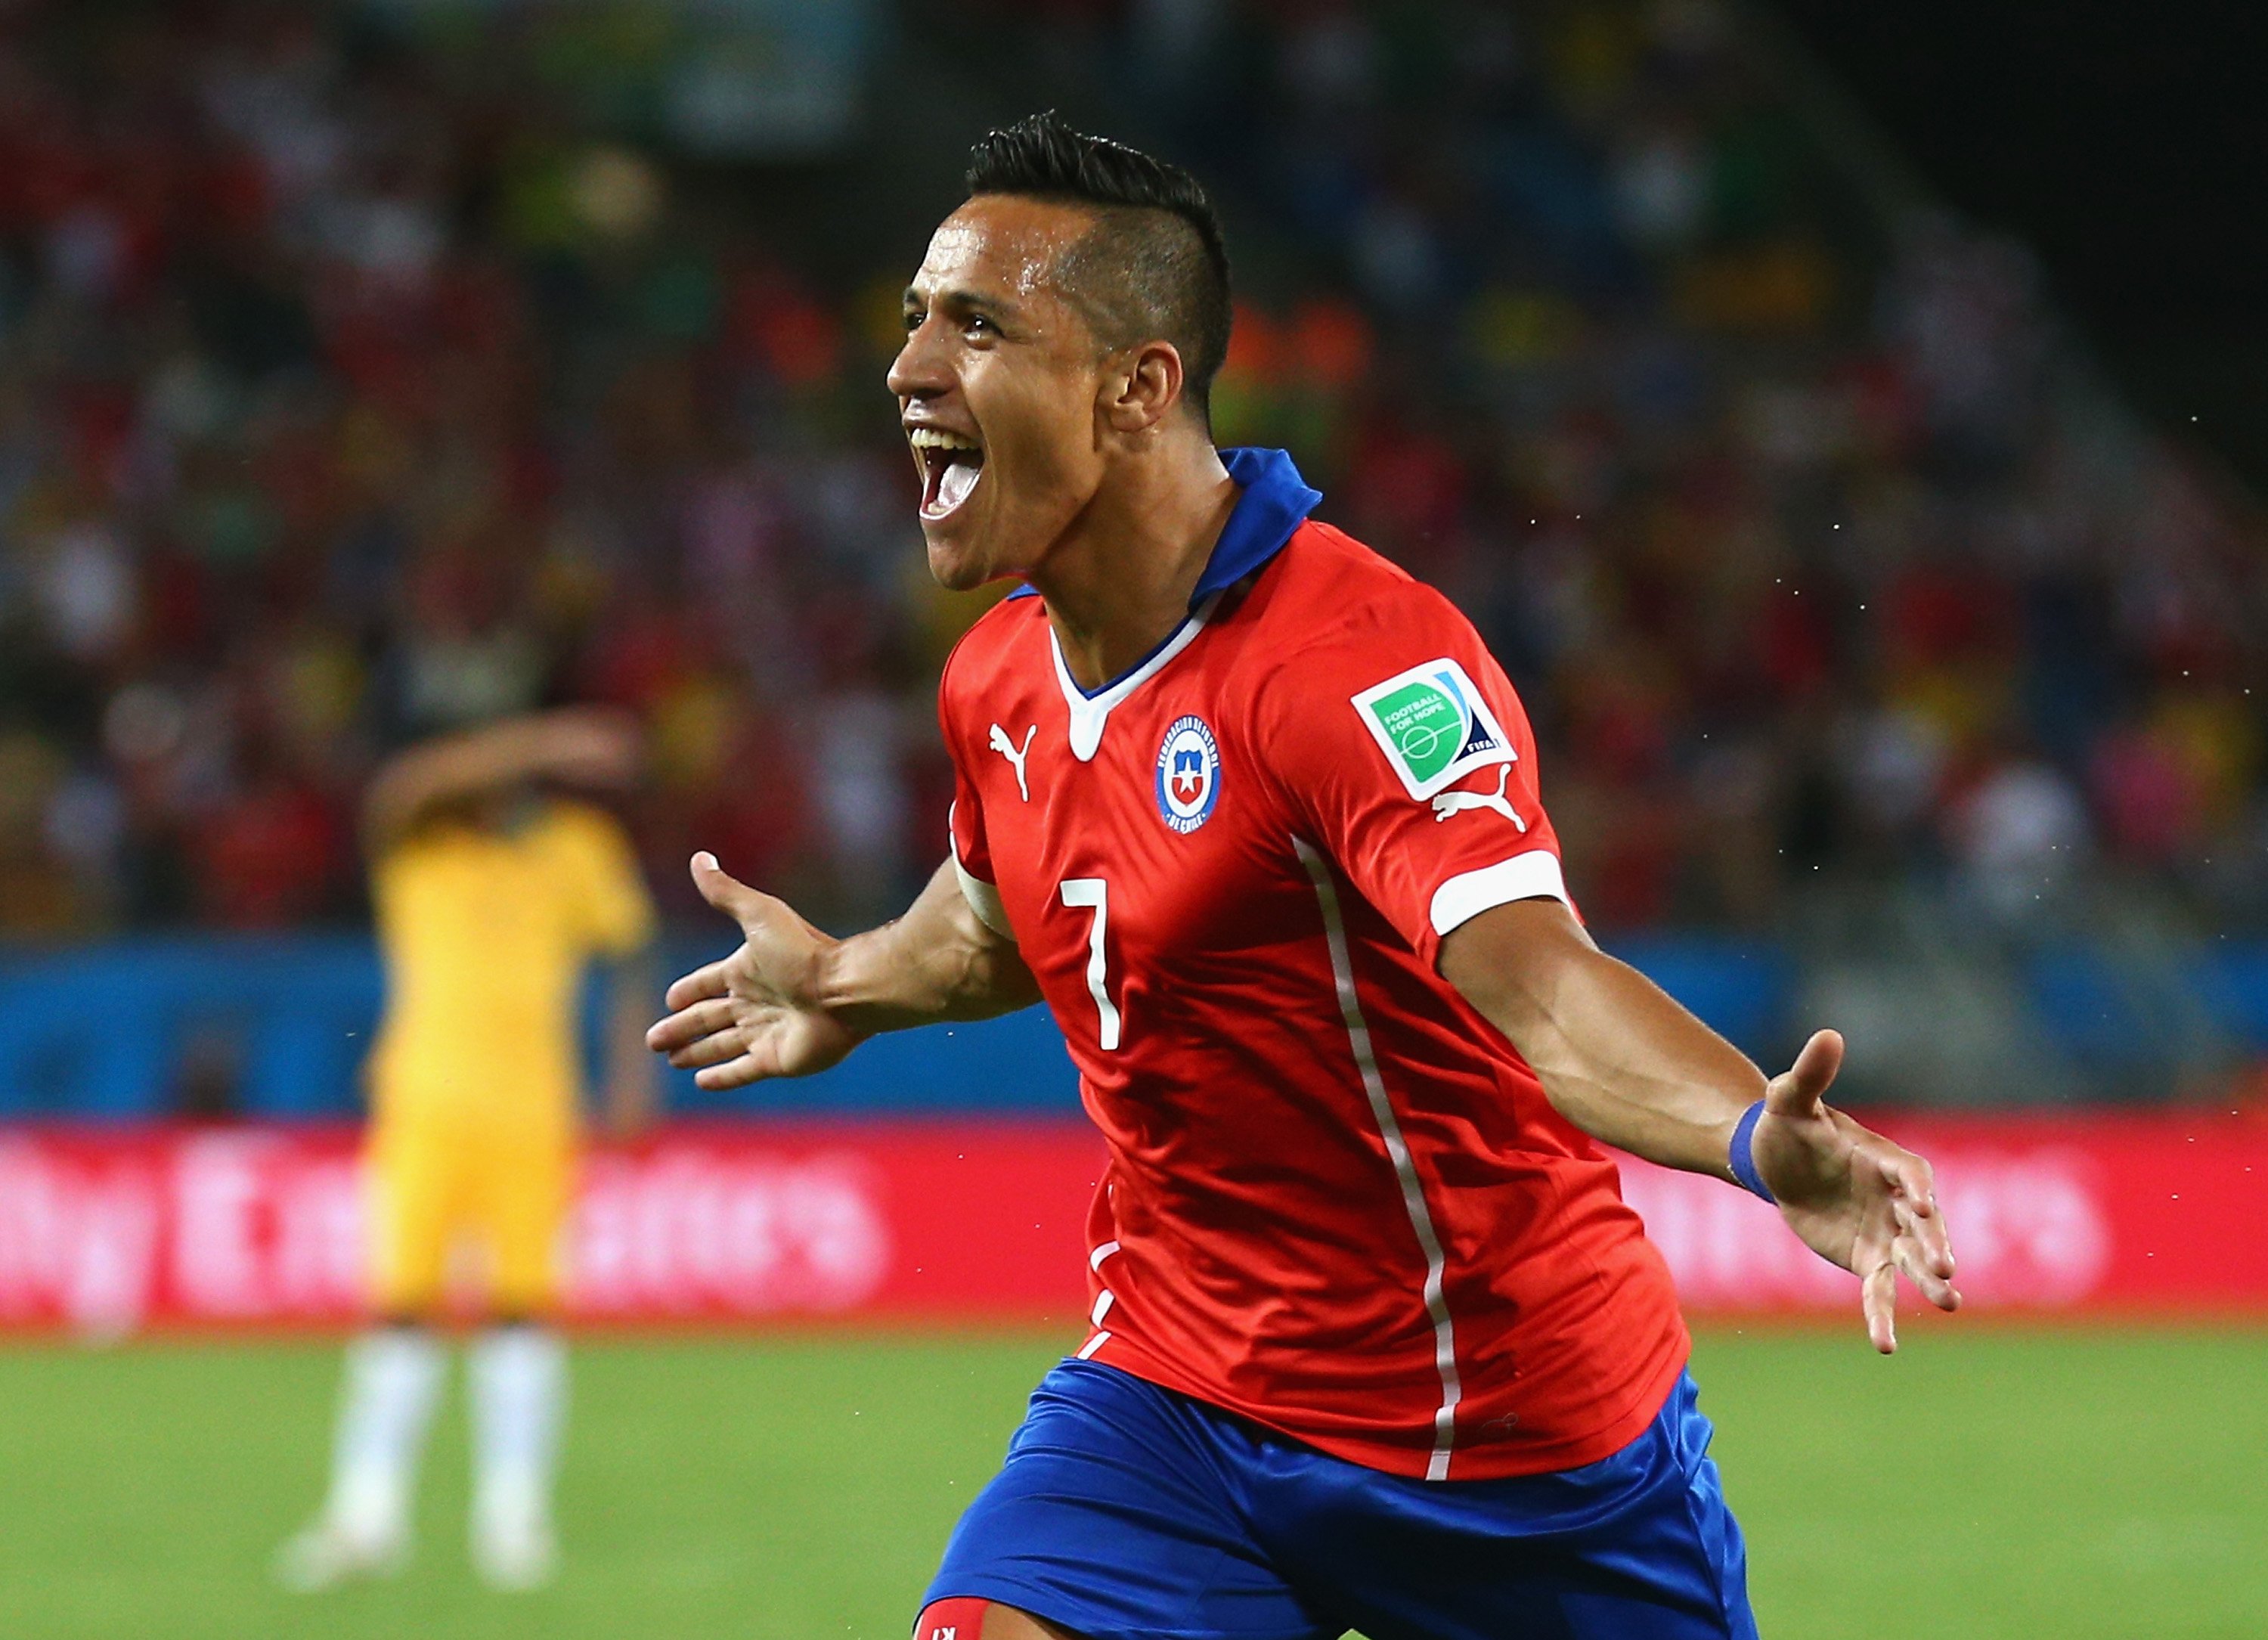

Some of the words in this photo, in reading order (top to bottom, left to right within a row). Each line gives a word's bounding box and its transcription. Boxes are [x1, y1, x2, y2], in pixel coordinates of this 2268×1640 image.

[1384, 694, 1442, 724] FOOTBALL
[1390, 717, 1414, 734] FOR
[1414, 702, 1445, 721] HOPE
[1467, 739, 1493, 752] FIFA
[1061, 879, 1120, 1049] 7
